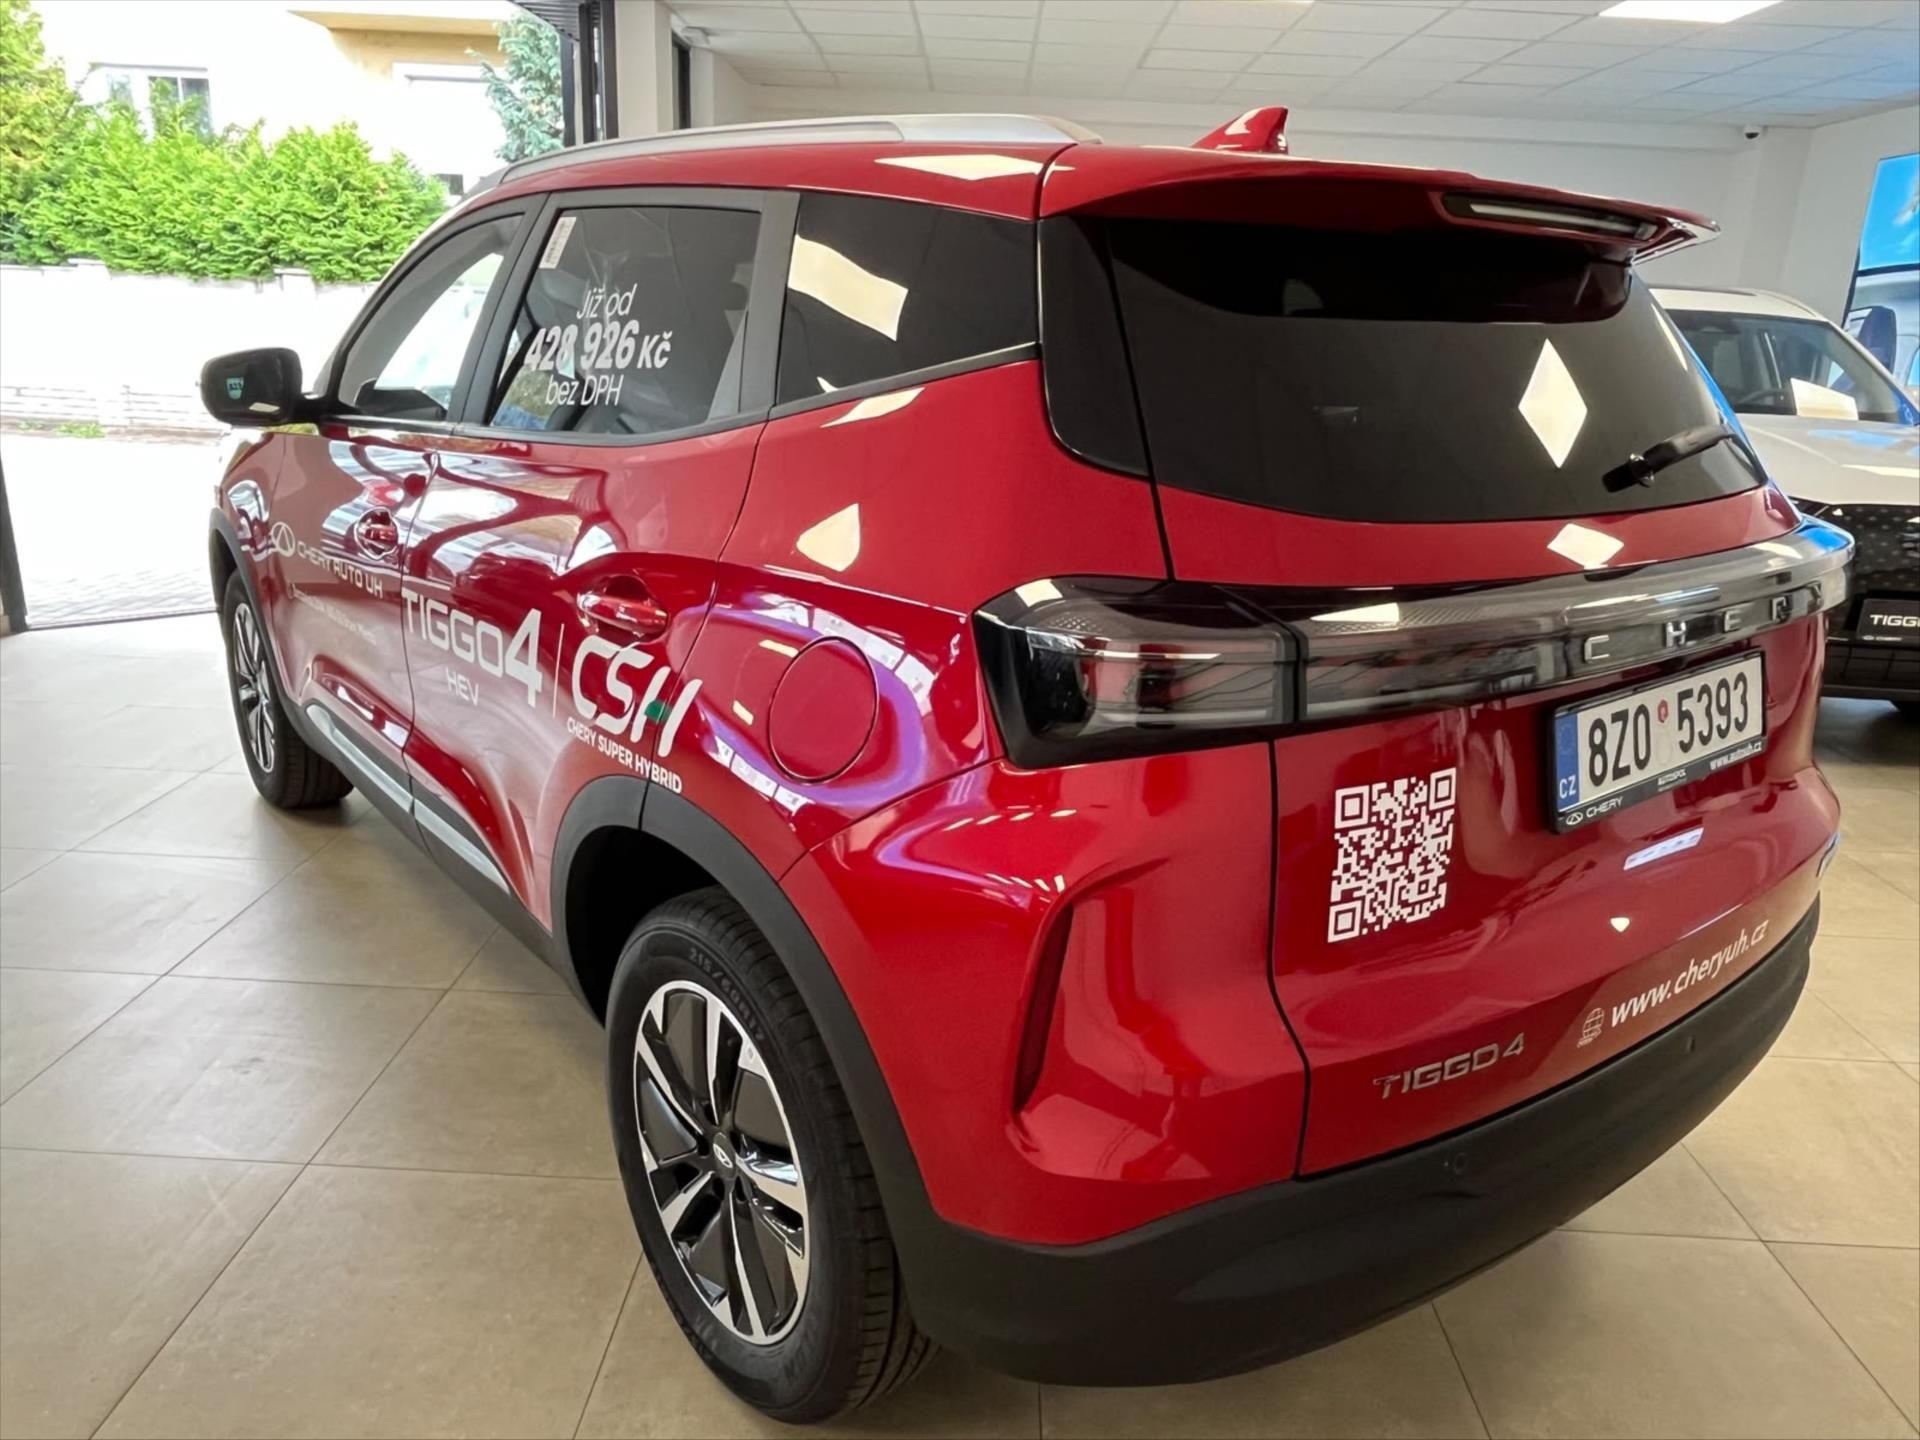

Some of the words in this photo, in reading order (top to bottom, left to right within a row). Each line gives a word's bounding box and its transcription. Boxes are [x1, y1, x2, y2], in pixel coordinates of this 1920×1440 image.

[576, 287, 606, 319] Již
[605, 283, 638, 316] od
[524, 323, 579, 372] 428
[580, 320, 640, 369] 926
[637, 330, 673, 369] Kč
[545, 374, 579, 405] bez
[580, 374, 624, 406] DPH
[333, 559, 363, 589] AUTO
[364, 573, 384, 599] UH
[1870, 613, 1920, 628] TIGG
[402, 586, 503, 678] TIGGO
[505, 608, 543, 708] 4
[446, 667, 479, 706] HEV
[571, 634, 703, 757] CSH
[1676, 671, 1748, 754] 5393
[566, 716, 596, 748] CHERY
[598, 734, 632, 769] SUPER
[634, 753, 682, 794] HYBRID
[1559, 775, 1577, 799] CZ
[1585, 796, 1623, 818] CHERY
[1610, 920, 1769, 1029] www.cheryuh.cz
[1372, 1043, 1499, 1100] TIGGO
[1502, 1032, 1526, 1058] 4
